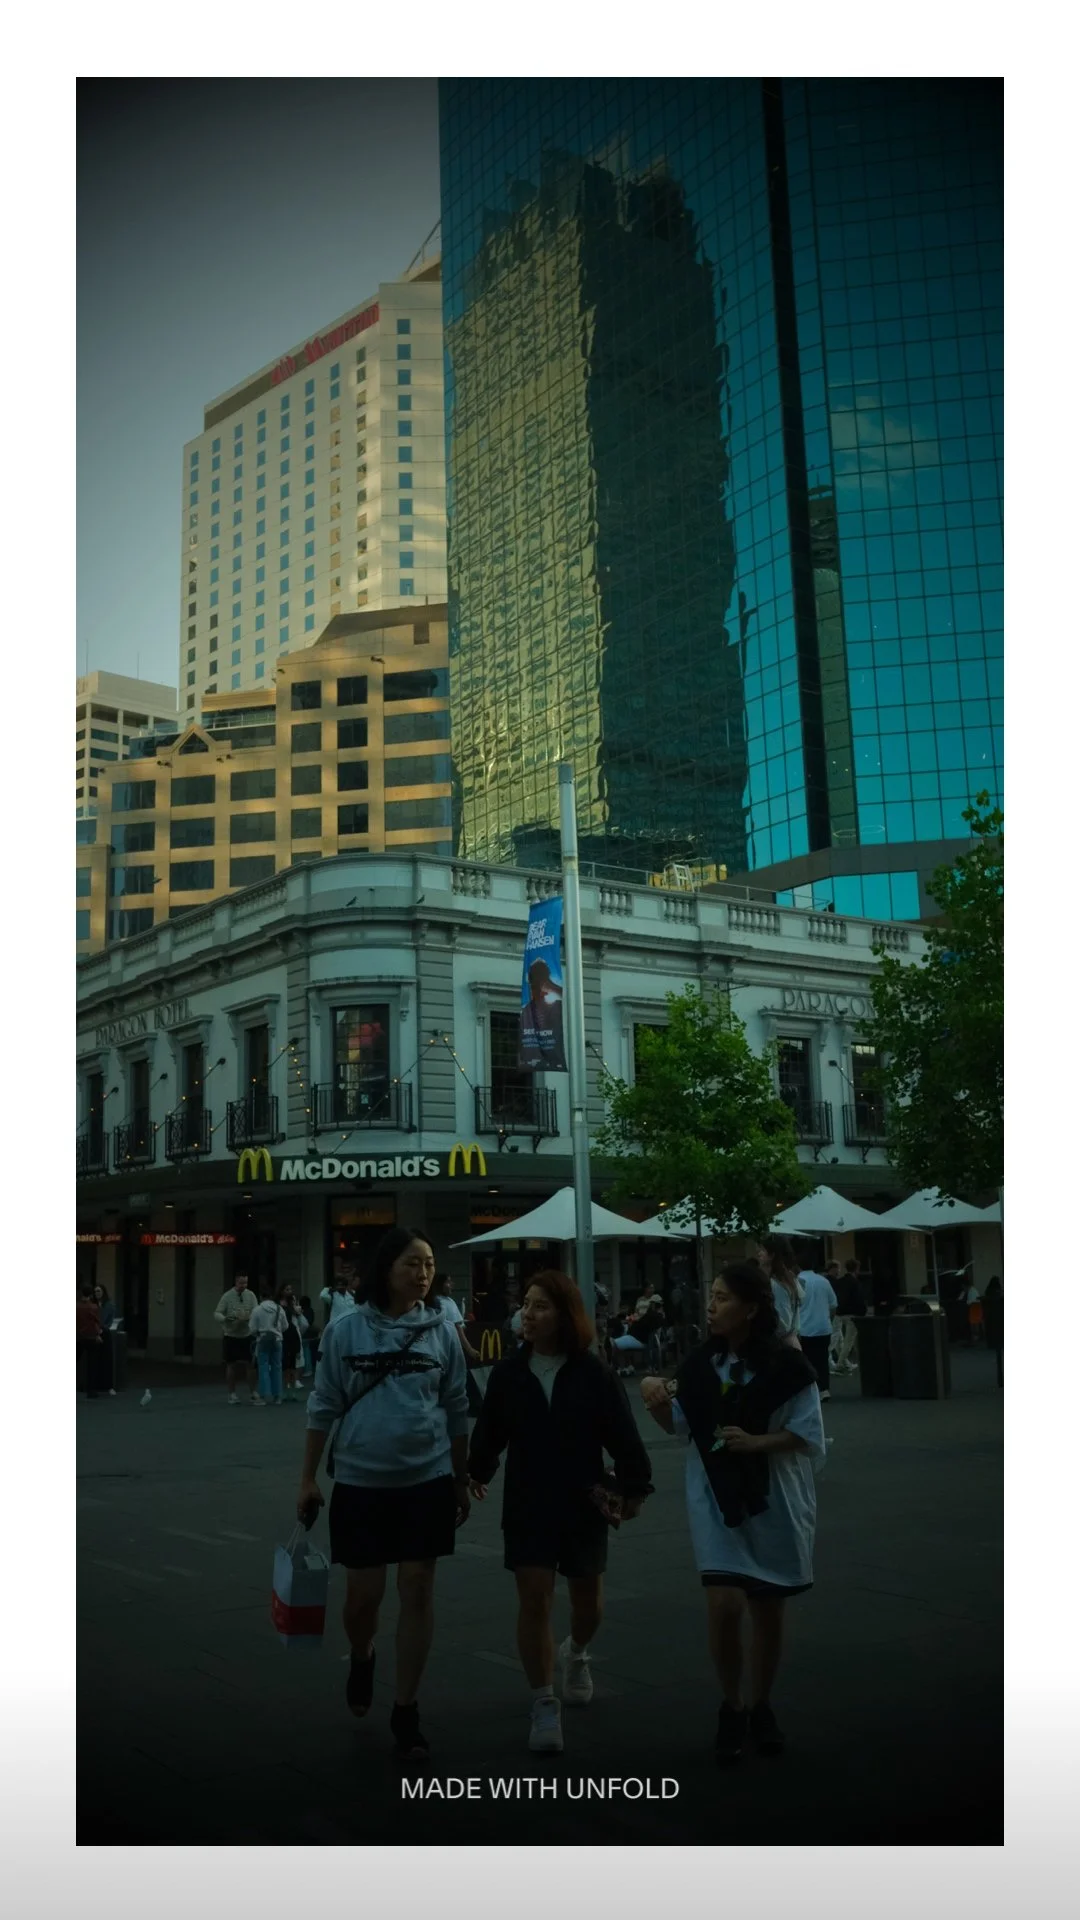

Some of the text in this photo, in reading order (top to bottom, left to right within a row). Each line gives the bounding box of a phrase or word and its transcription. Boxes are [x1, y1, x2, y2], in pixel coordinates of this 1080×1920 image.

[96, 998, 191, 1045] PARAGON HOTEL
[280, 1156, 441, 1181] McDonald's
[156, 1233, 214, 1245] McDonald's
